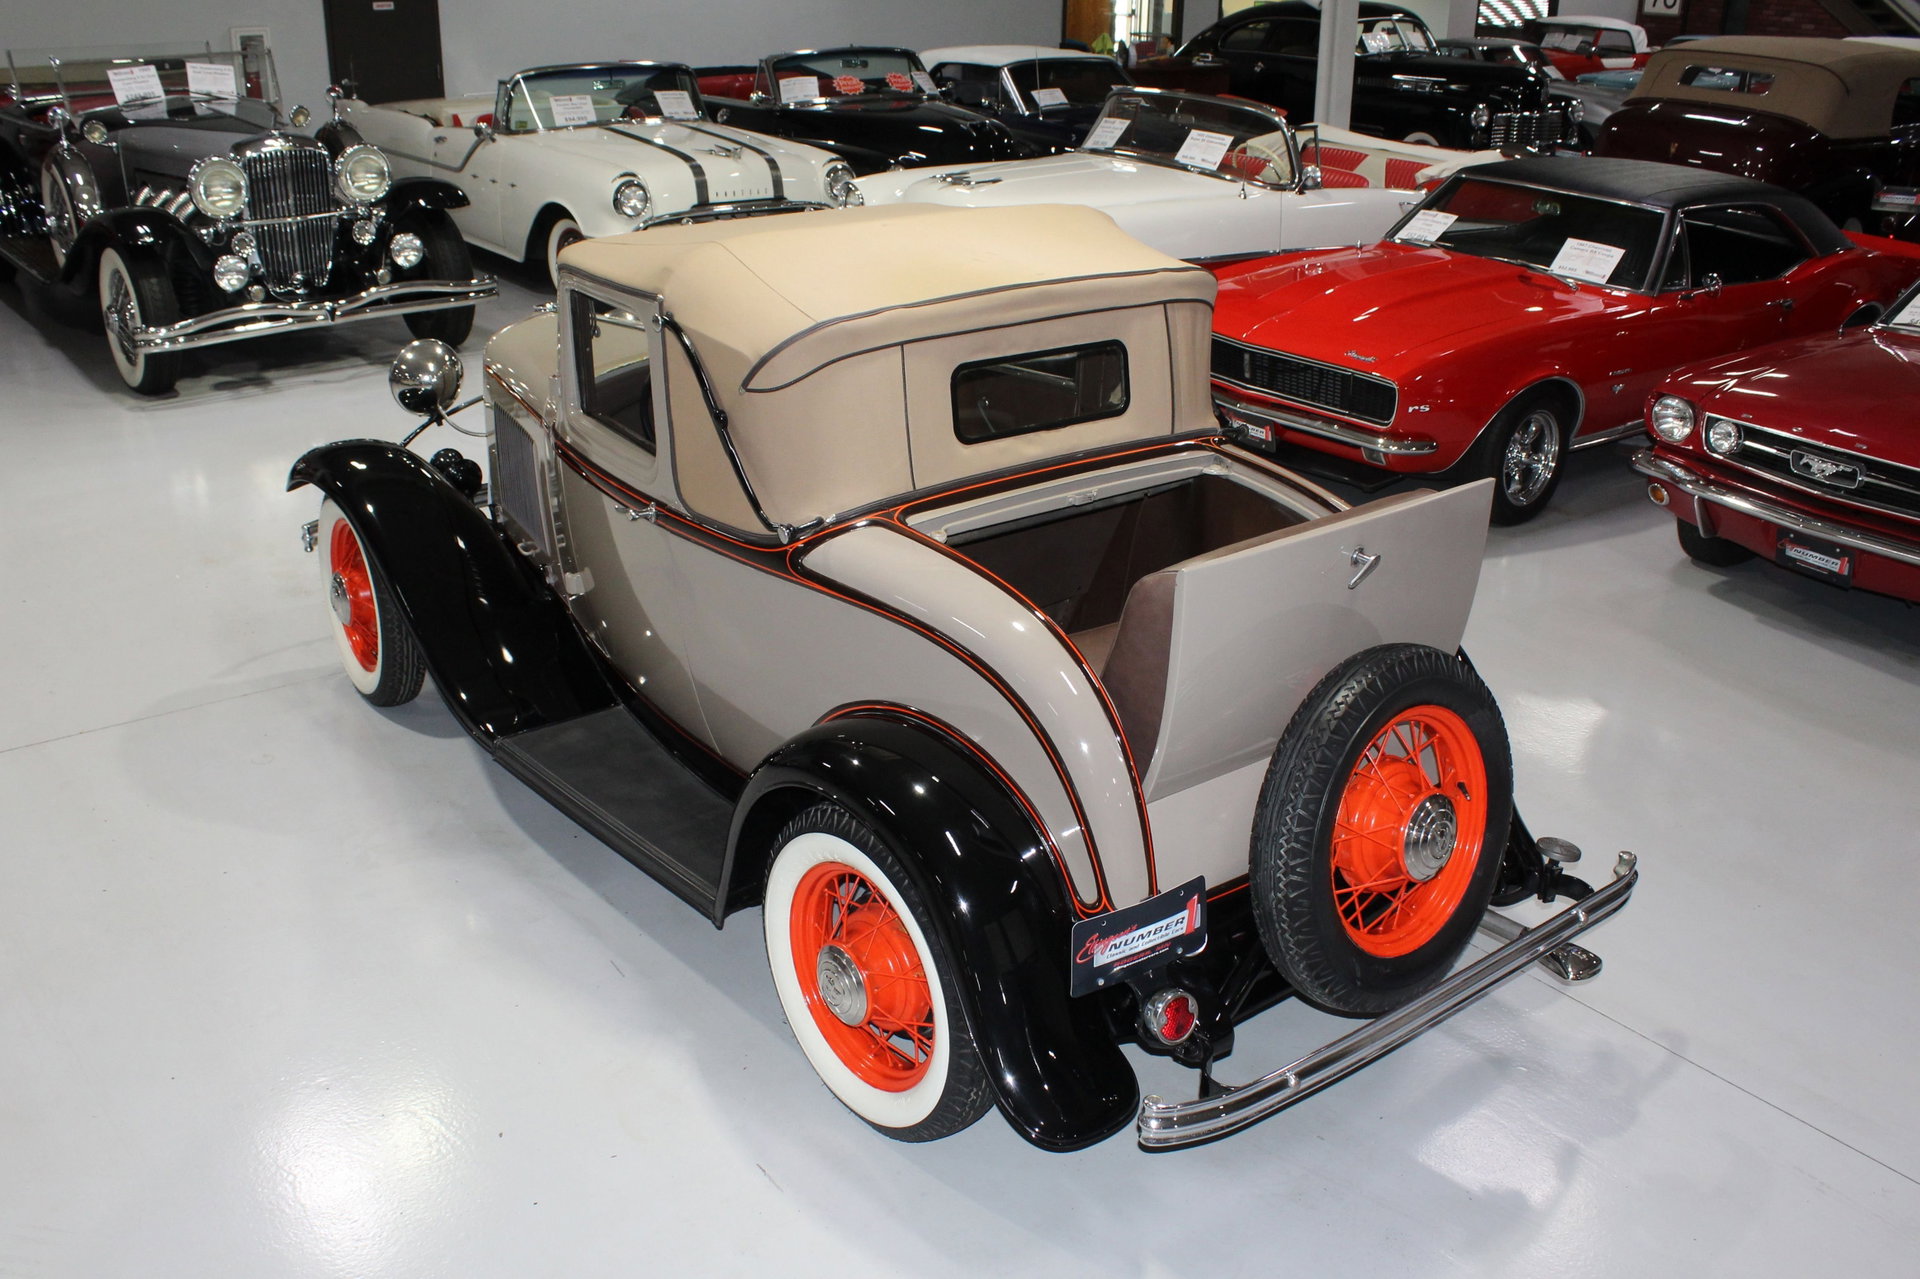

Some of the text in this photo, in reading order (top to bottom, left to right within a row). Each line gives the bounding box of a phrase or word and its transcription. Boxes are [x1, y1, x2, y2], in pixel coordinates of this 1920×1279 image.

[1793, 547, 1839, 566] NUMBER
[1108, 893, 1200, 952] NUMBER 1
